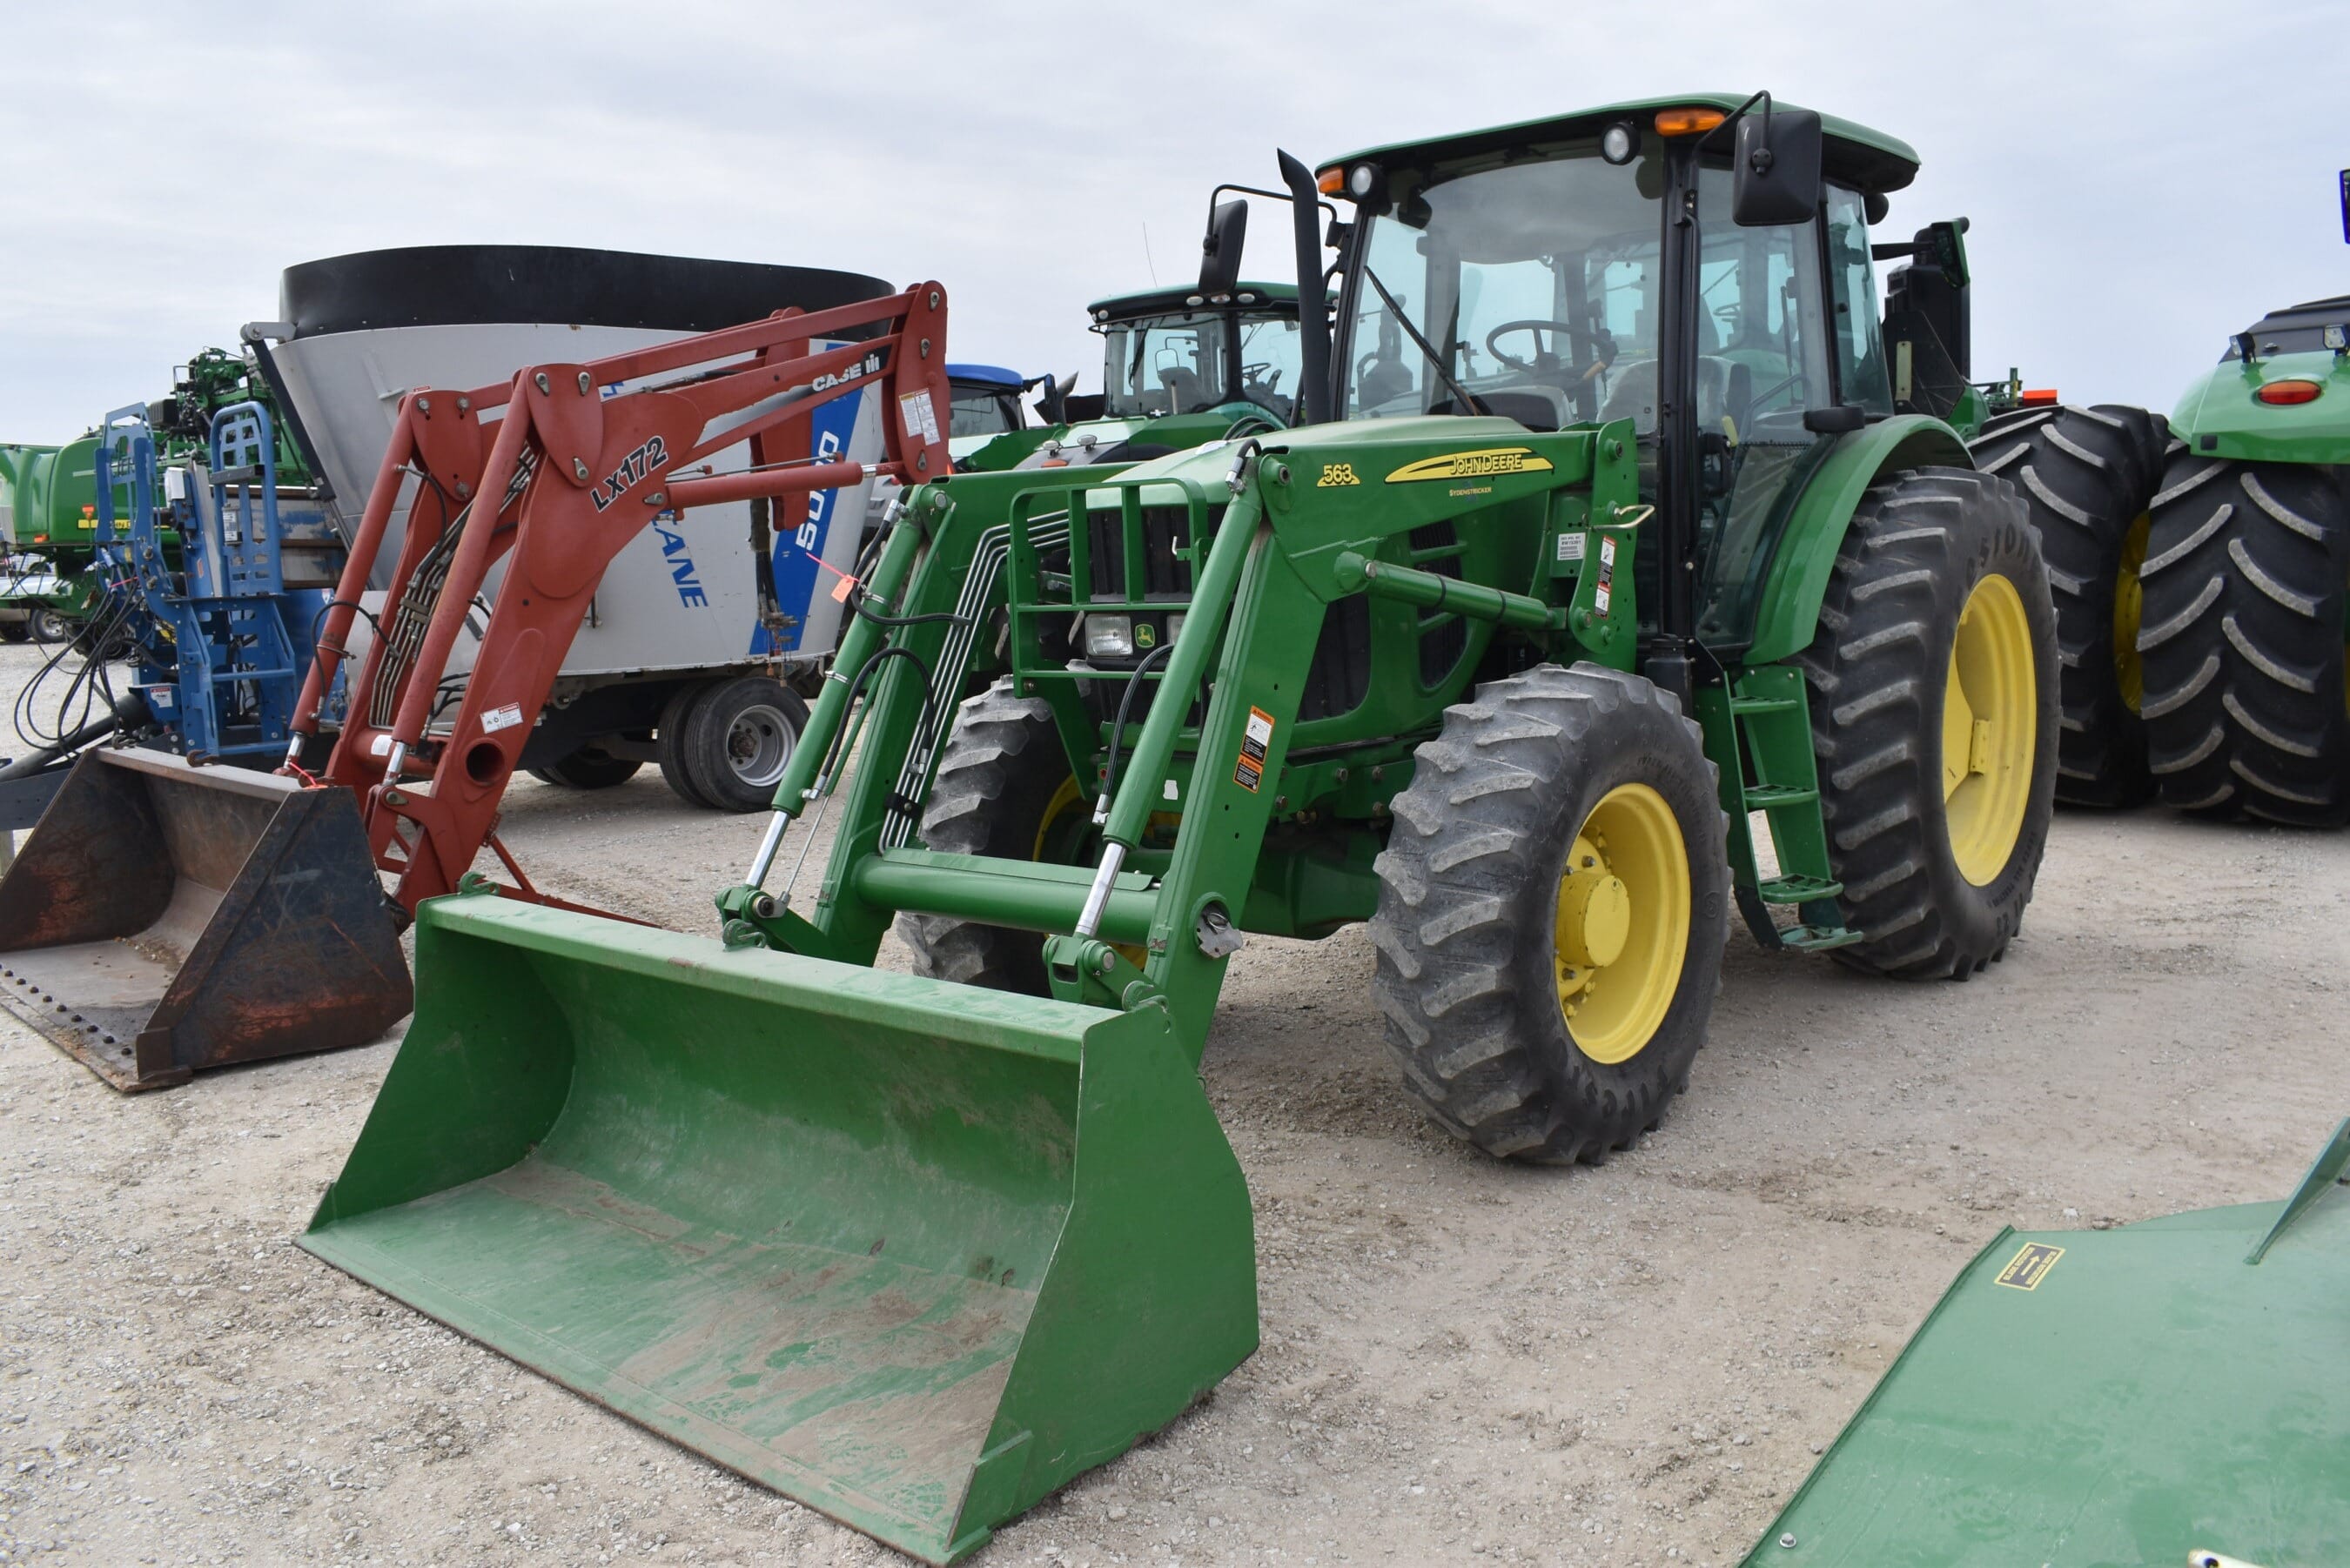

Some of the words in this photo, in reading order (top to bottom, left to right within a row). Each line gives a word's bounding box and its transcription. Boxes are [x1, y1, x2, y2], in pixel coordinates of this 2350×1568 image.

[812, 362, 862, 392] CASE
[590, 435, 668, 513] LX172
[796, 431, 840, 551] 500
[1323, 463, 1352, 484] 563
